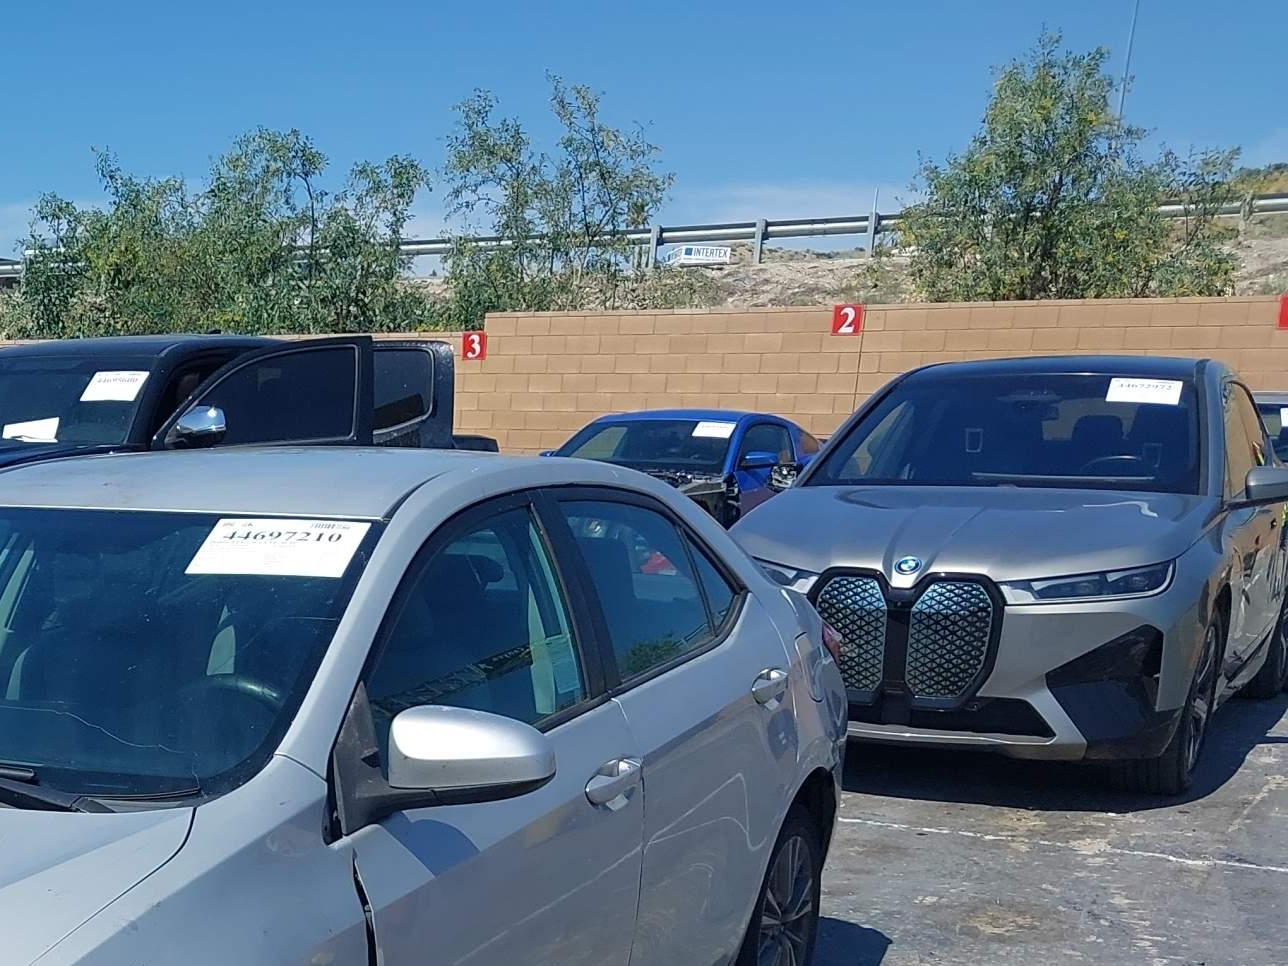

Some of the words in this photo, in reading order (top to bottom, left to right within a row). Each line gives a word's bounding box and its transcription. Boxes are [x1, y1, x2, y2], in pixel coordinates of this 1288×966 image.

[694, 247, 729, 258] INTERTEX
[838, 307, 856, 333] 2
[467, 334, 481, 358] 3
[223, 530, 343, 543] 44697210
